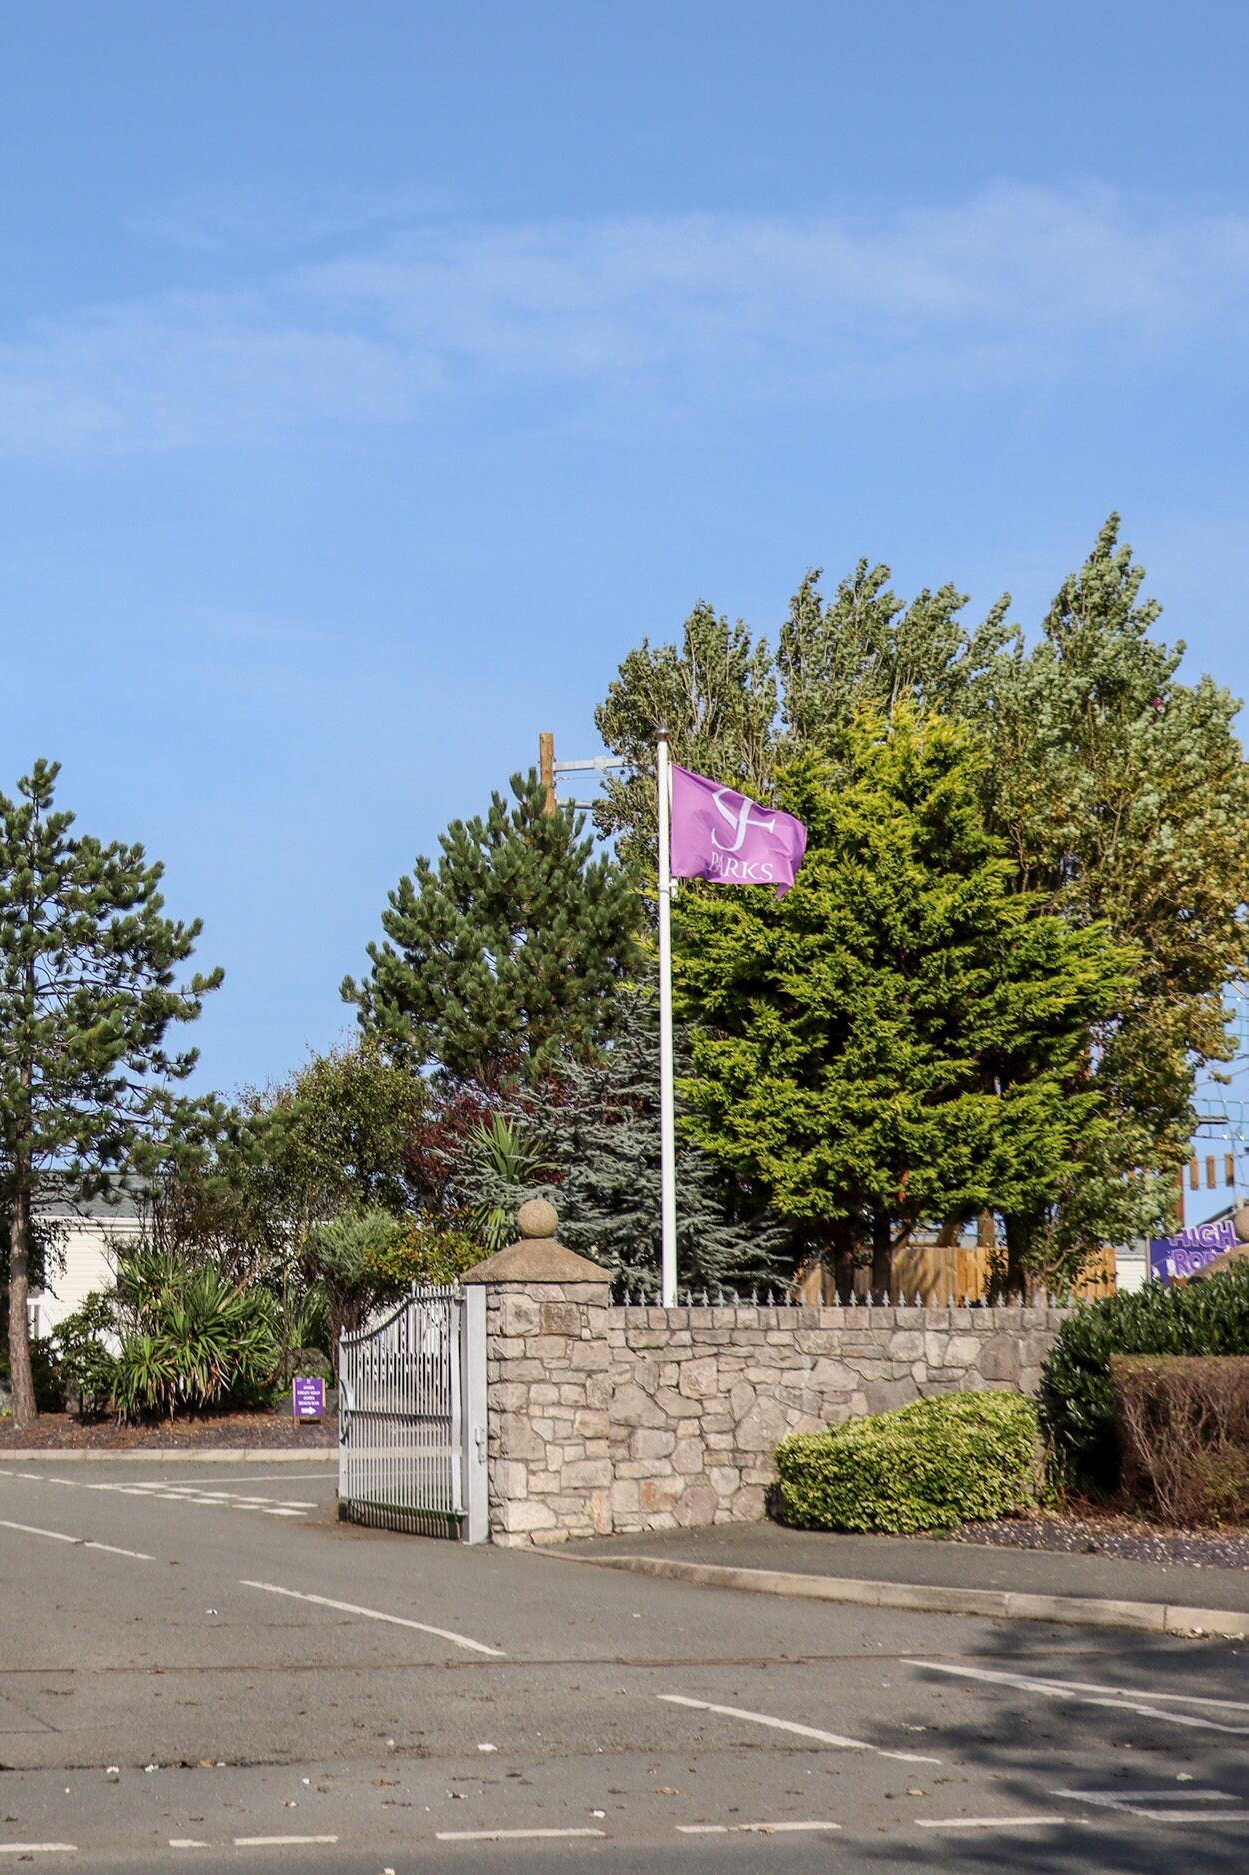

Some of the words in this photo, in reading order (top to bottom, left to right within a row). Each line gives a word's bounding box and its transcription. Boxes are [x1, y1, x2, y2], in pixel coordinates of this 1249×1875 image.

[709, 851, 774, 882] PARKS
[1169, 1220, 1236, 1248] HIGH
[1171, 1248, 1221, 1277] ROP
